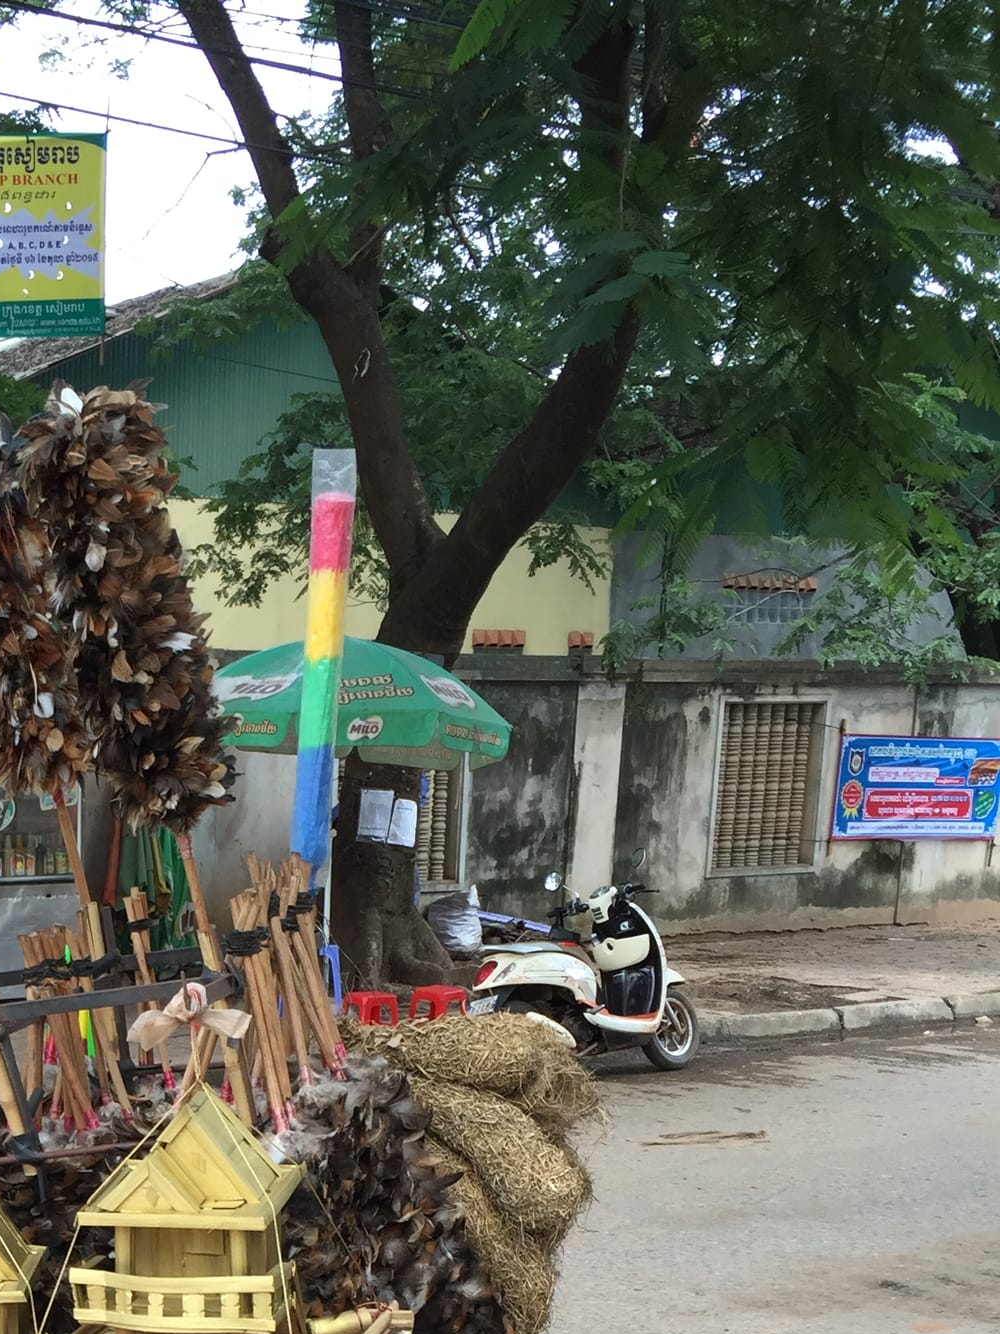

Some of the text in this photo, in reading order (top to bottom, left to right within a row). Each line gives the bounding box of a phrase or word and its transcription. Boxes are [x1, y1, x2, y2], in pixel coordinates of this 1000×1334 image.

[12, 173, 79, 186] BRANCH
[8, 240, 62, 250] A, B, C, D & E
[425, 680, 470, 702] MILO
[349, 723, 379, 734] MILO
